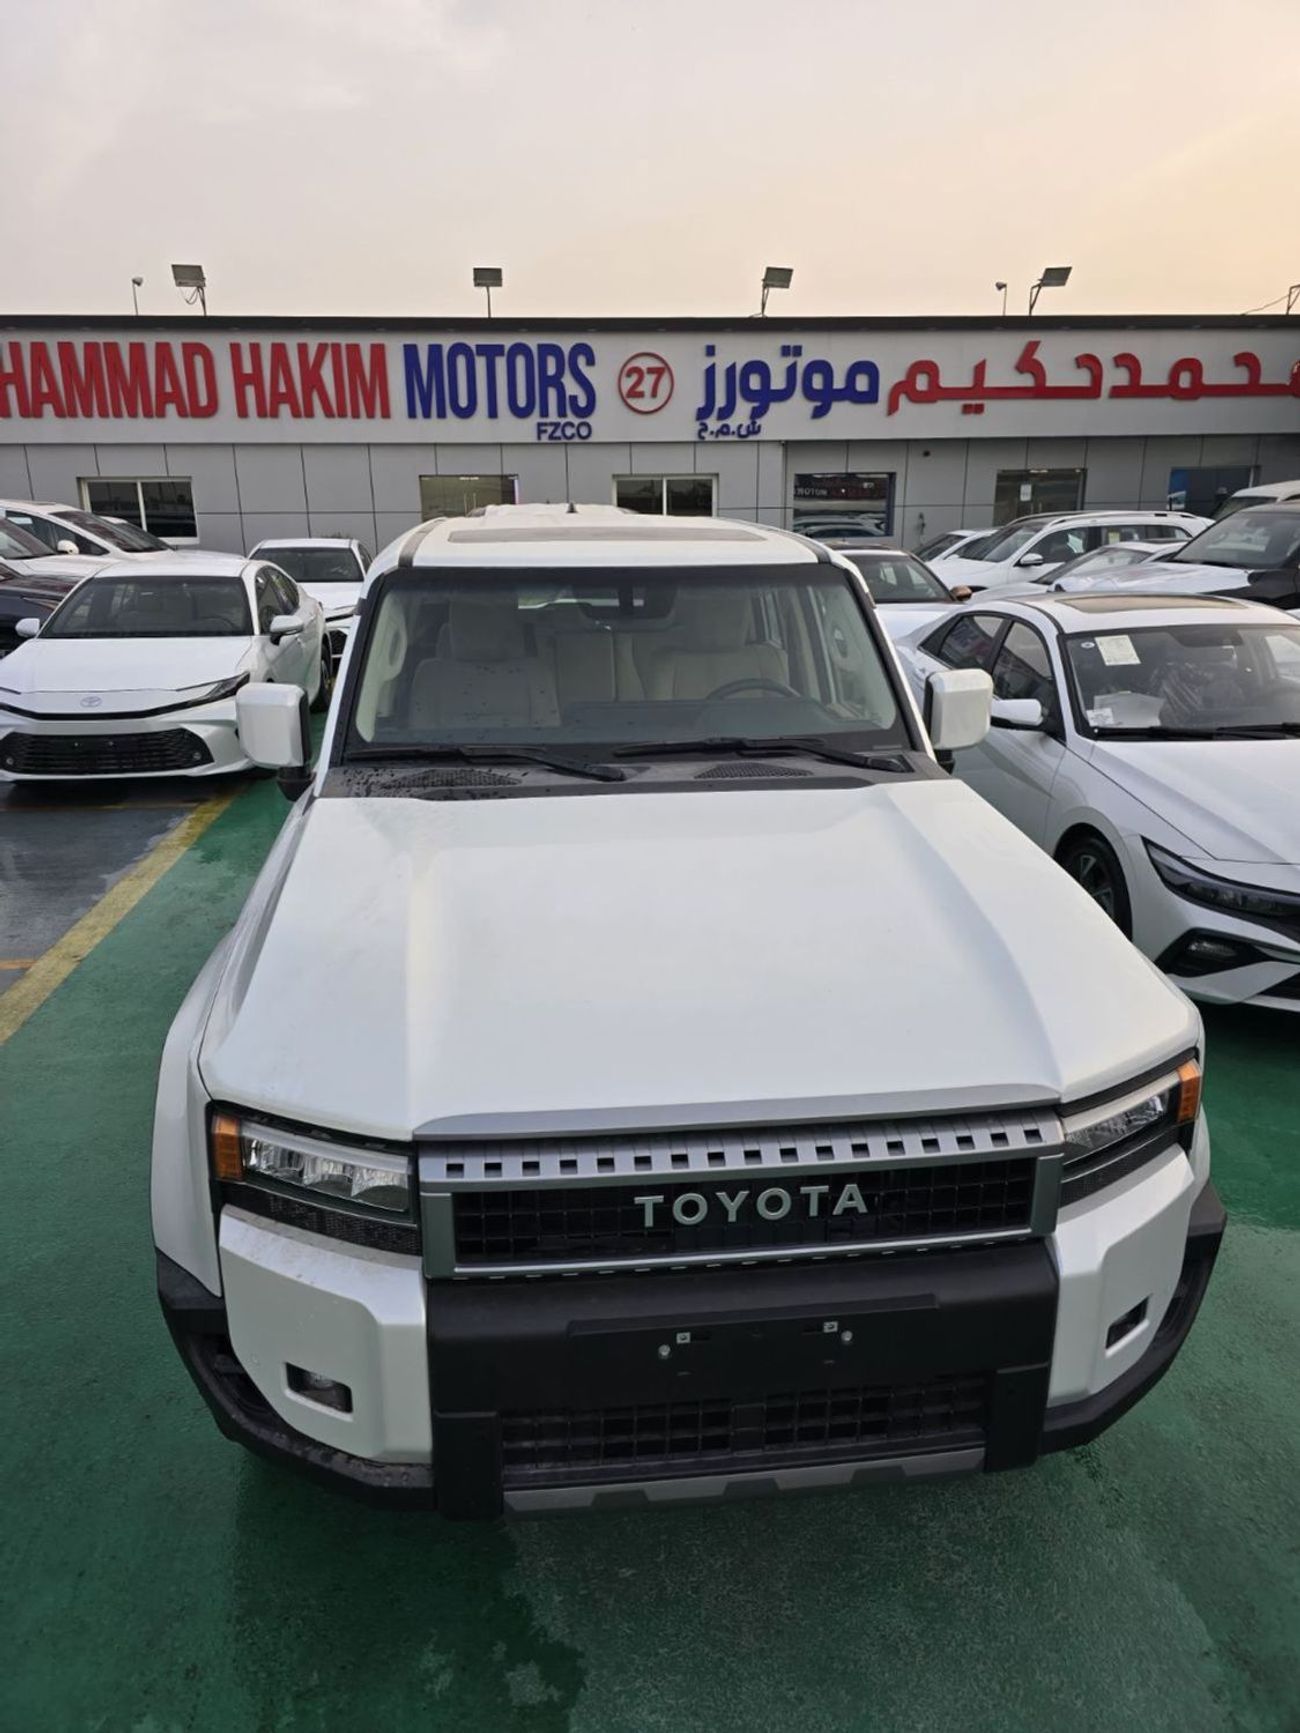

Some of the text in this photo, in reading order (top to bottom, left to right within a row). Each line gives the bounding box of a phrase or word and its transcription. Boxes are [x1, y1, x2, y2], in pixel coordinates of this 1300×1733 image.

[0, 341, 596, 419] HAMMAD HAKIM MOTORS
[625, 366, 666, 399] 27
[696, 344, 880, 421] موتورز
[536, 421, 593, 441] FZCO
[634, 1183, 869, 1228] TOYOTA
